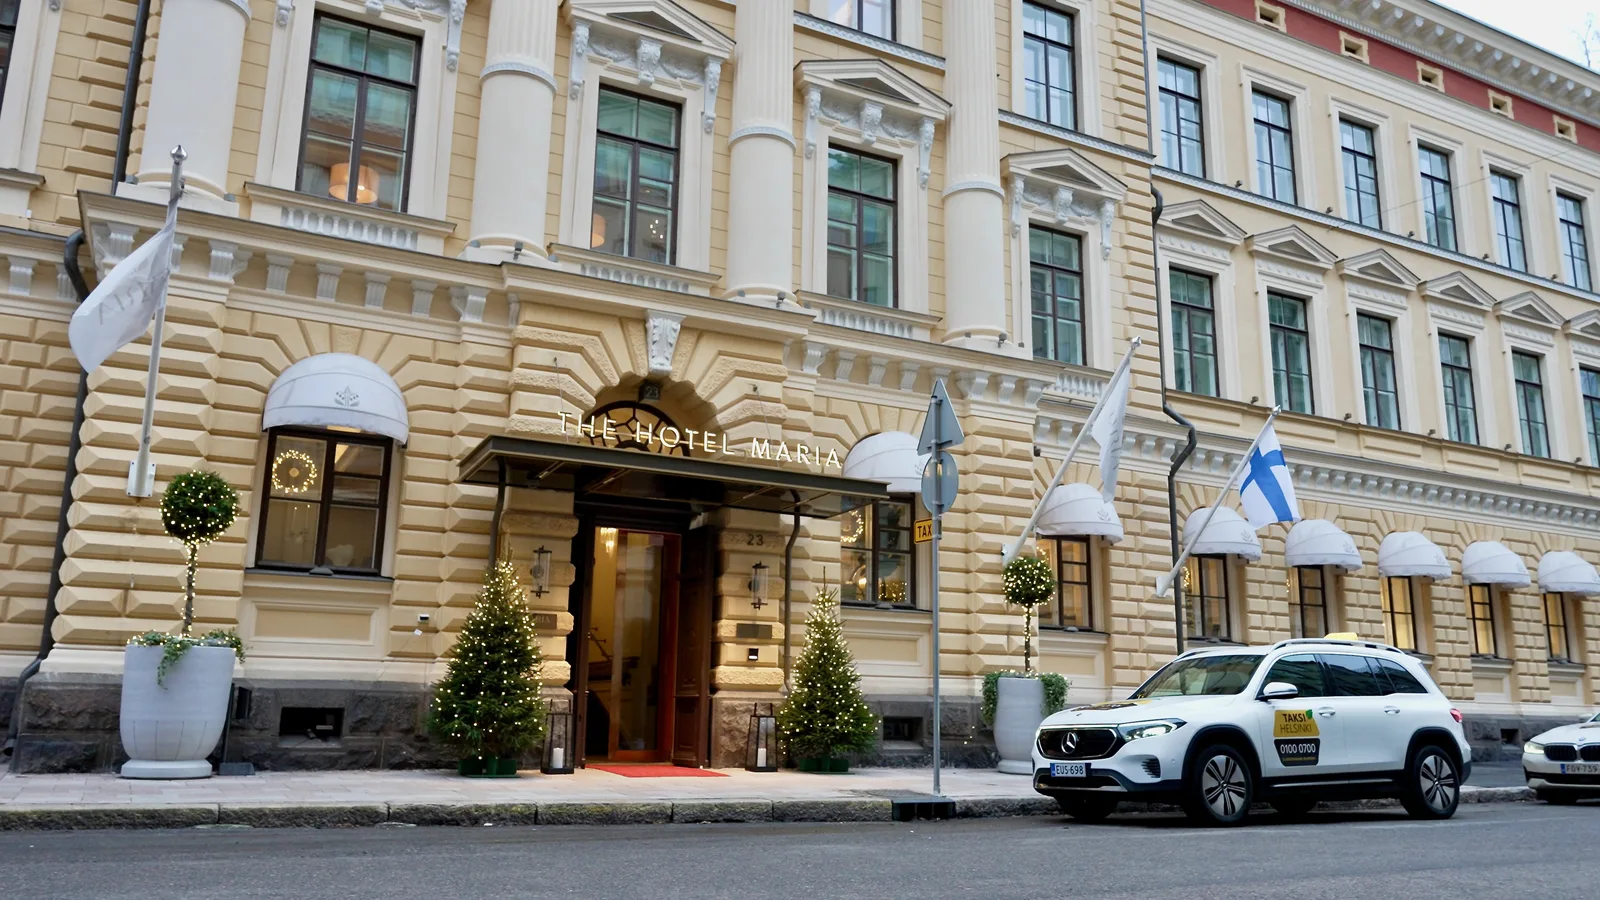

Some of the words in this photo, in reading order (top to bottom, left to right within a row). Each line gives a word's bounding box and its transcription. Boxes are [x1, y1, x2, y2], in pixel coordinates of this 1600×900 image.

[645, 385, 659, 398] 23
[558, 411, 617, 440] THE
[636, 421, 735, 455] HOTEL
[751, 437, 843, 469] MARIA
[917, 524, 932, 538] TAX
[747, 533, 764, 547] 23
[1282, 713, 1307, 723] TAKSI
[1279, 723, 1312, 734] HELSINKI
[1280, 744, 1297, 754] 0100
[1298, 743, 1316, 753] 0700
[1056, 765, 1084, 775] EUS-698
